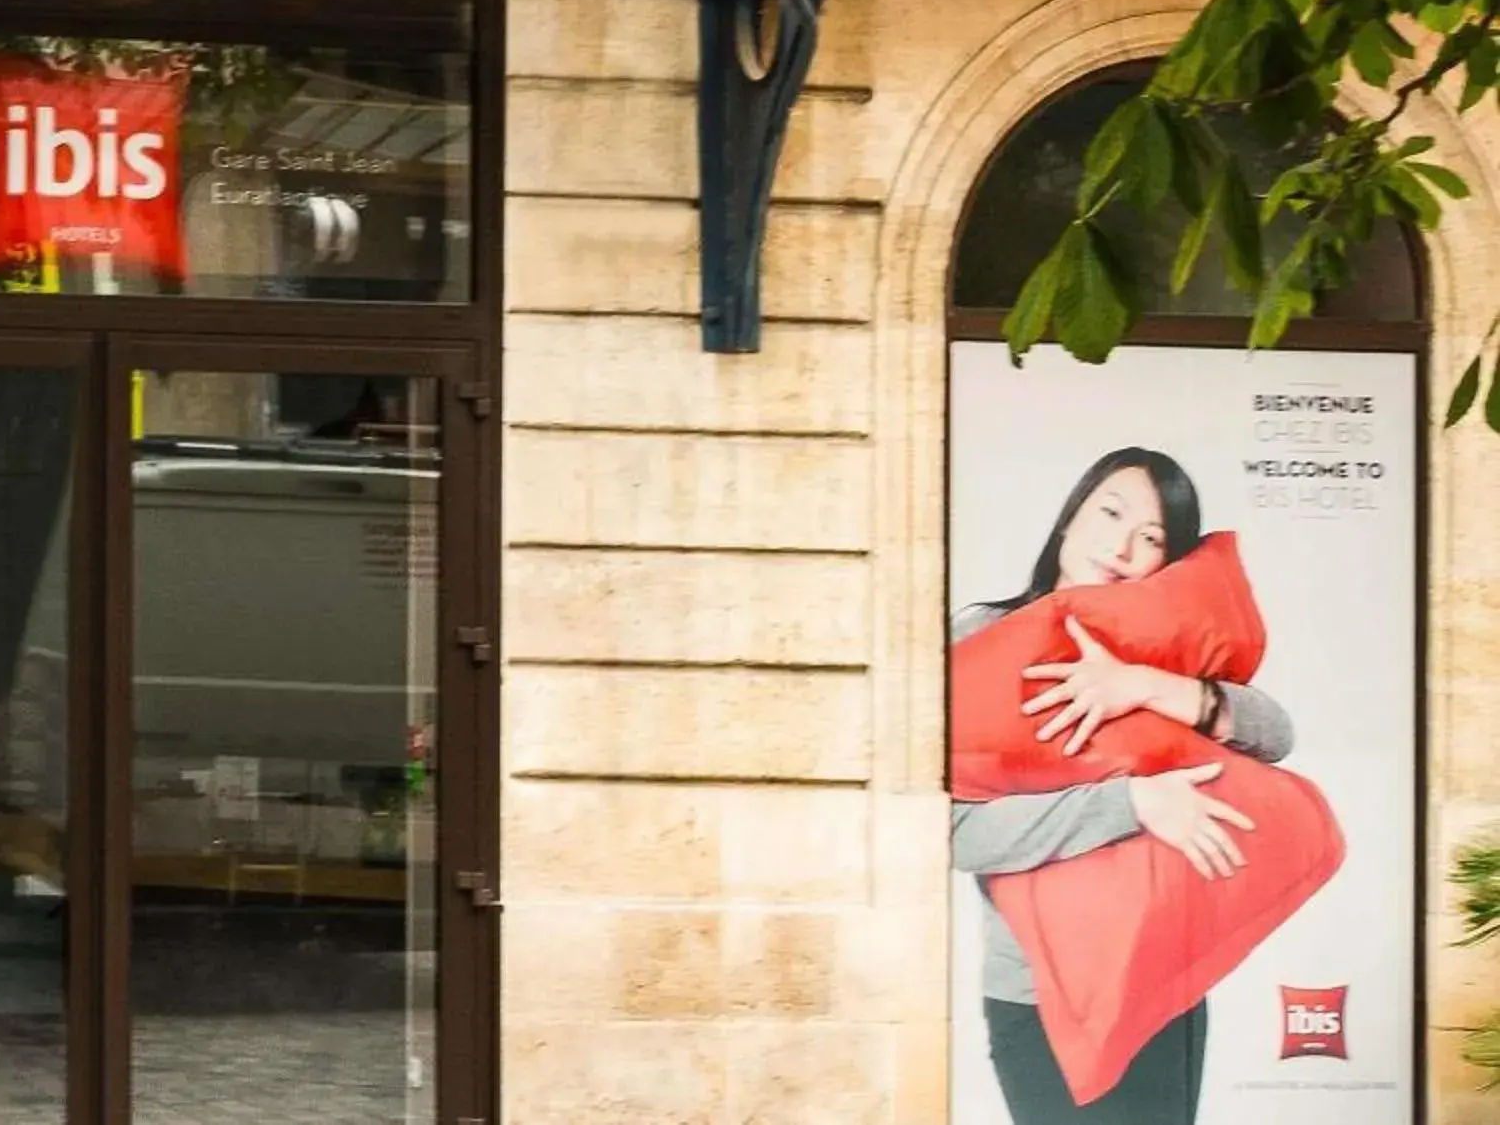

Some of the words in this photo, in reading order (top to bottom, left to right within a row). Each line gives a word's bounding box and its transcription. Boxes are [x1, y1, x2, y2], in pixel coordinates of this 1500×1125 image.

[5, 105, 167, 200] ibis
[210, 146, 272, 170] Gare
[1253, 394, 1375, 414] BIENVENUE
[1242, 460, 1350, 478] WELCOME
[1355, 461, 1386, 479] TO
[1286, 1005, 1340, 1035] ibis
